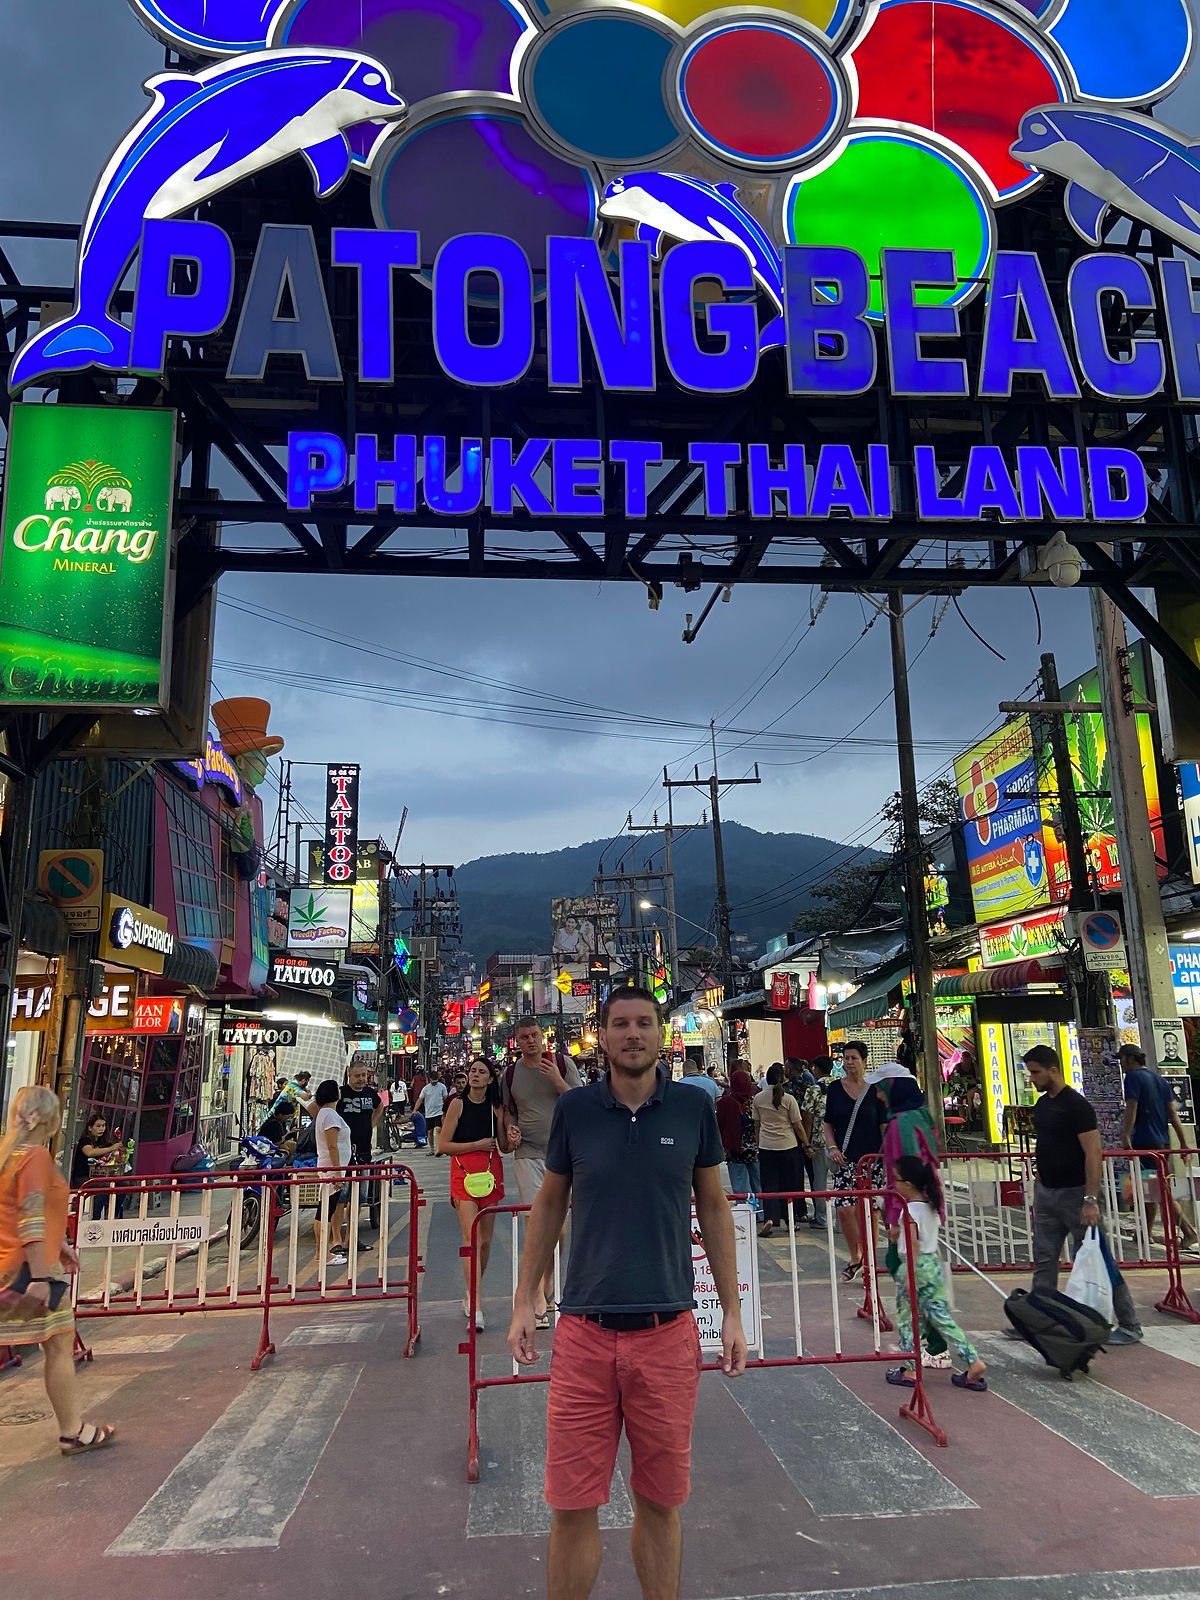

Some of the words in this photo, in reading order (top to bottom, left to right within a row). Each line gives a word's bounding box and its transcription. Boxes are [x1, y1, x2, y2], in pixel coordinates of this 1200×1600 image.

[129, 218, 759, 394] PATONG
[287, 431, 662, 518] PHUKET
[13, 514, 158, 563] Chang
[205, 740, 239, 794] Factory
[327, 776, 353, 881] TATTOO
[991, 803, 1038, 839] PHARMACY
[133, 919, 174, 955] SUPERRICH
[273, 964, 336, 987] TATTOO
[1180, 972, 1200, 984] an
[222, 1028, 293, 1045] TATTOO
[112, 1219, 202, 1243] เทศบาลเมืองป่าตอง
